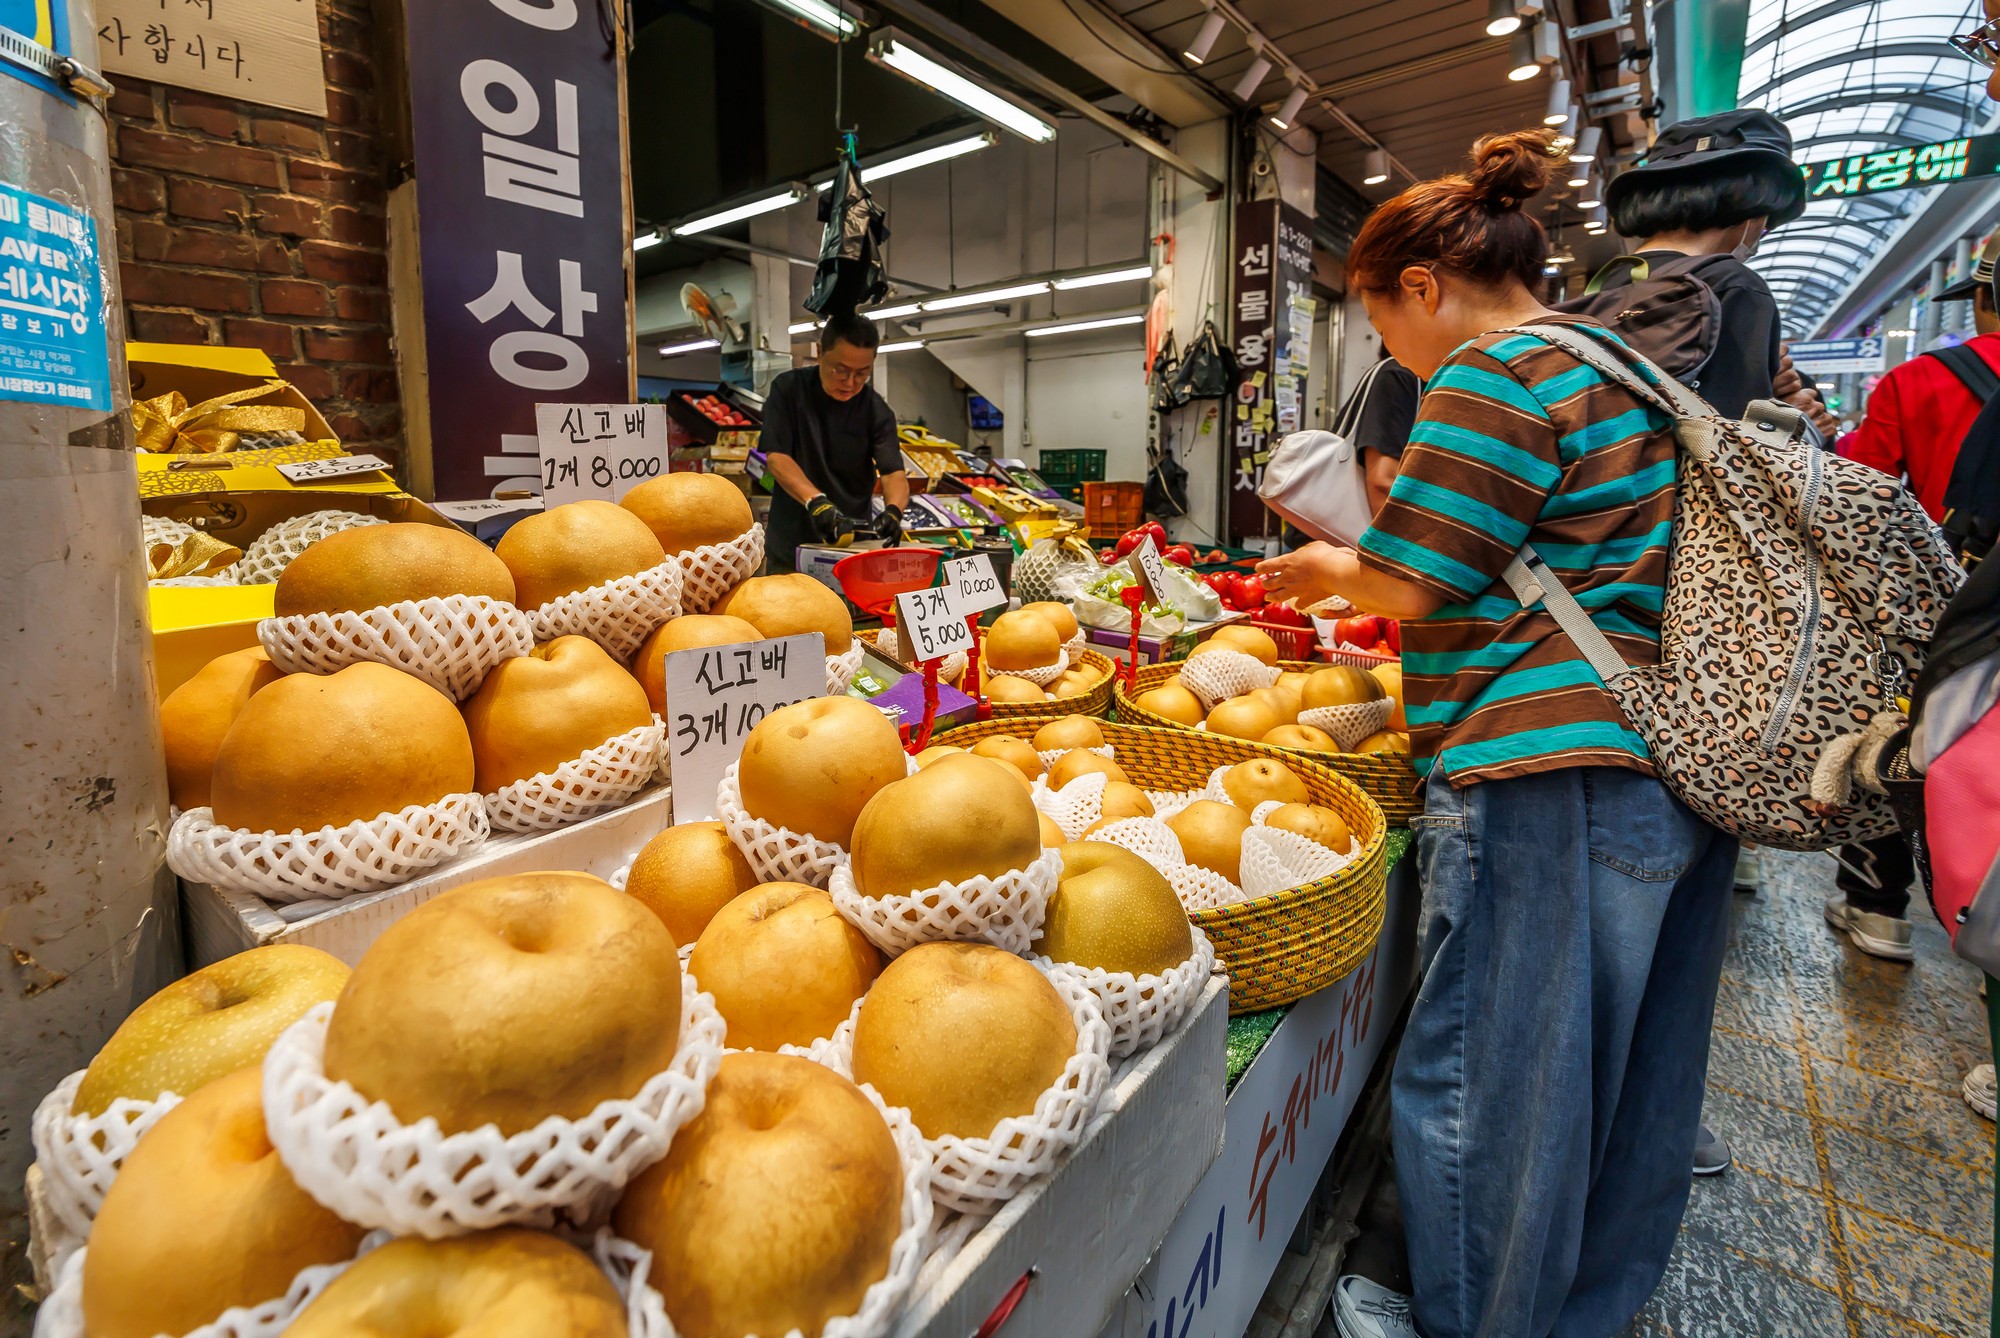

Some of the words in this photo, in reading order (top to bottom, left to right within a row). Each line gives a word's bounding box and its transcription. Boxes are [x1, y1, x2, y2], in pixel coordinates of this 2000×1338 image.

[1800, 138, 1972, 196] 시장에
[560, 407, 645, 443] 신고배
[544, 456, 579, 490] 1개
[591, 456, 660, 488] 8.000
[912, 588, 950, 621] 3개
[960, 578, 995, 598] 10.000
[918, 622, 965, 654] 5.000
[695, 641, 788, 695] 신고배
[677, 703, 728, 756] 3개
